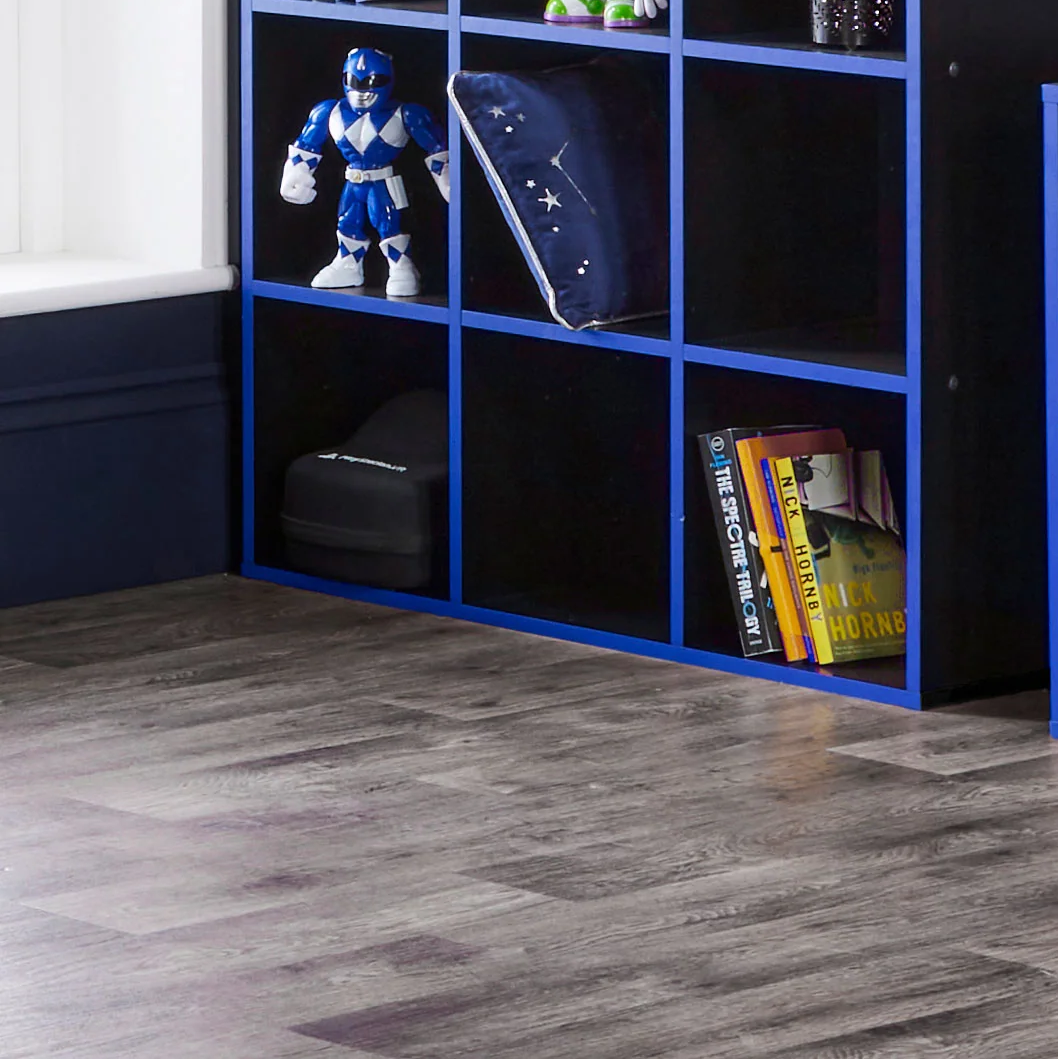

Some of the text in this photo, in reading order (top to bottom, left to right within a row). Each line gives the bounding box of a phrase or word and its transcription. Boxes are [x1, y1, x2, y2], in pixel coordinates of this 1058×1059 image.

[714, 466, 734, 496] THE
[721, 496, 748, 569] SPECTRE
[781, 476, 800, 519] NICK
[795, 544, 823, 622] HORNBY
[736, 569, 761, 636] TRILOGY
[823, 581, 877, 610] NICK
[828, 610, 906, 642] HORNB
